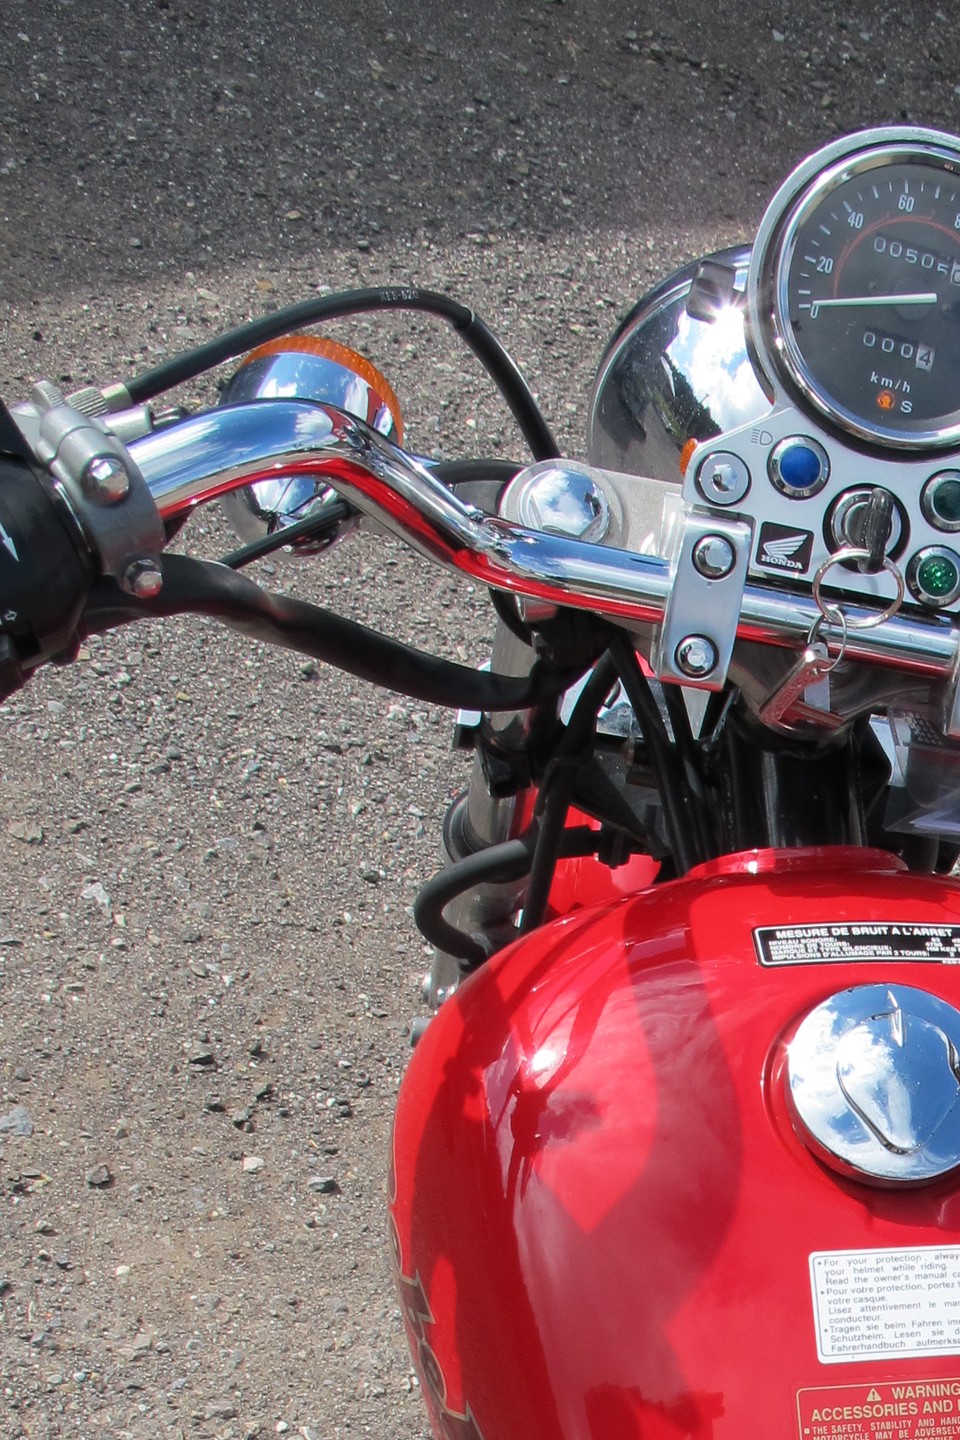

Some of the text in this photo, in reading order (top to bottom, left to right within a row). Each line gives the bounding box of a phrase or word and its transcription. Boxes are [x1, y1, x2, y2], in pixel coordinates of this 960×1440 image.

[898, 195, 914, 212] 60
[848, 210, 864, 229] 40
[816, 256, 834, 274] 20
[870, 372, 911, 393] km/h
[900, 400, 913, 413] S
[760, 554, 804, 570] HONDA
[776, 926, 952, 939] MESURE DE BRUIT A L'ARRET
[824, 1263, 915, 1277] your while
[846, 1258, 868, 1267] your
[825, 1276, 848, 1285] Read
[914, 1271, 947, 1279] manual
[826, 1287, 848, 1295] Pour
[859, 1302, 920, 1312] attentivement
[829, 1324, 861, 1334] Tragen
[911, 1319, 942, 1327] Fahren
[830, 1340, 906, 1352] Fahrerhandbuch
[810, 1401, 918, 1422] ACCESSORIES
[921, 1399, 953, 1414] AND
[812, 1425, 827, 1434] THE
[870, 1418, 912, 1430] STABILITY
[917, 1417, 934, 1427] AND
[875, 1430, 892, 1440] MAY
[898, 1429, 908, 1438] BE
[914, 1425, 960, 1437] ADVERSELY
